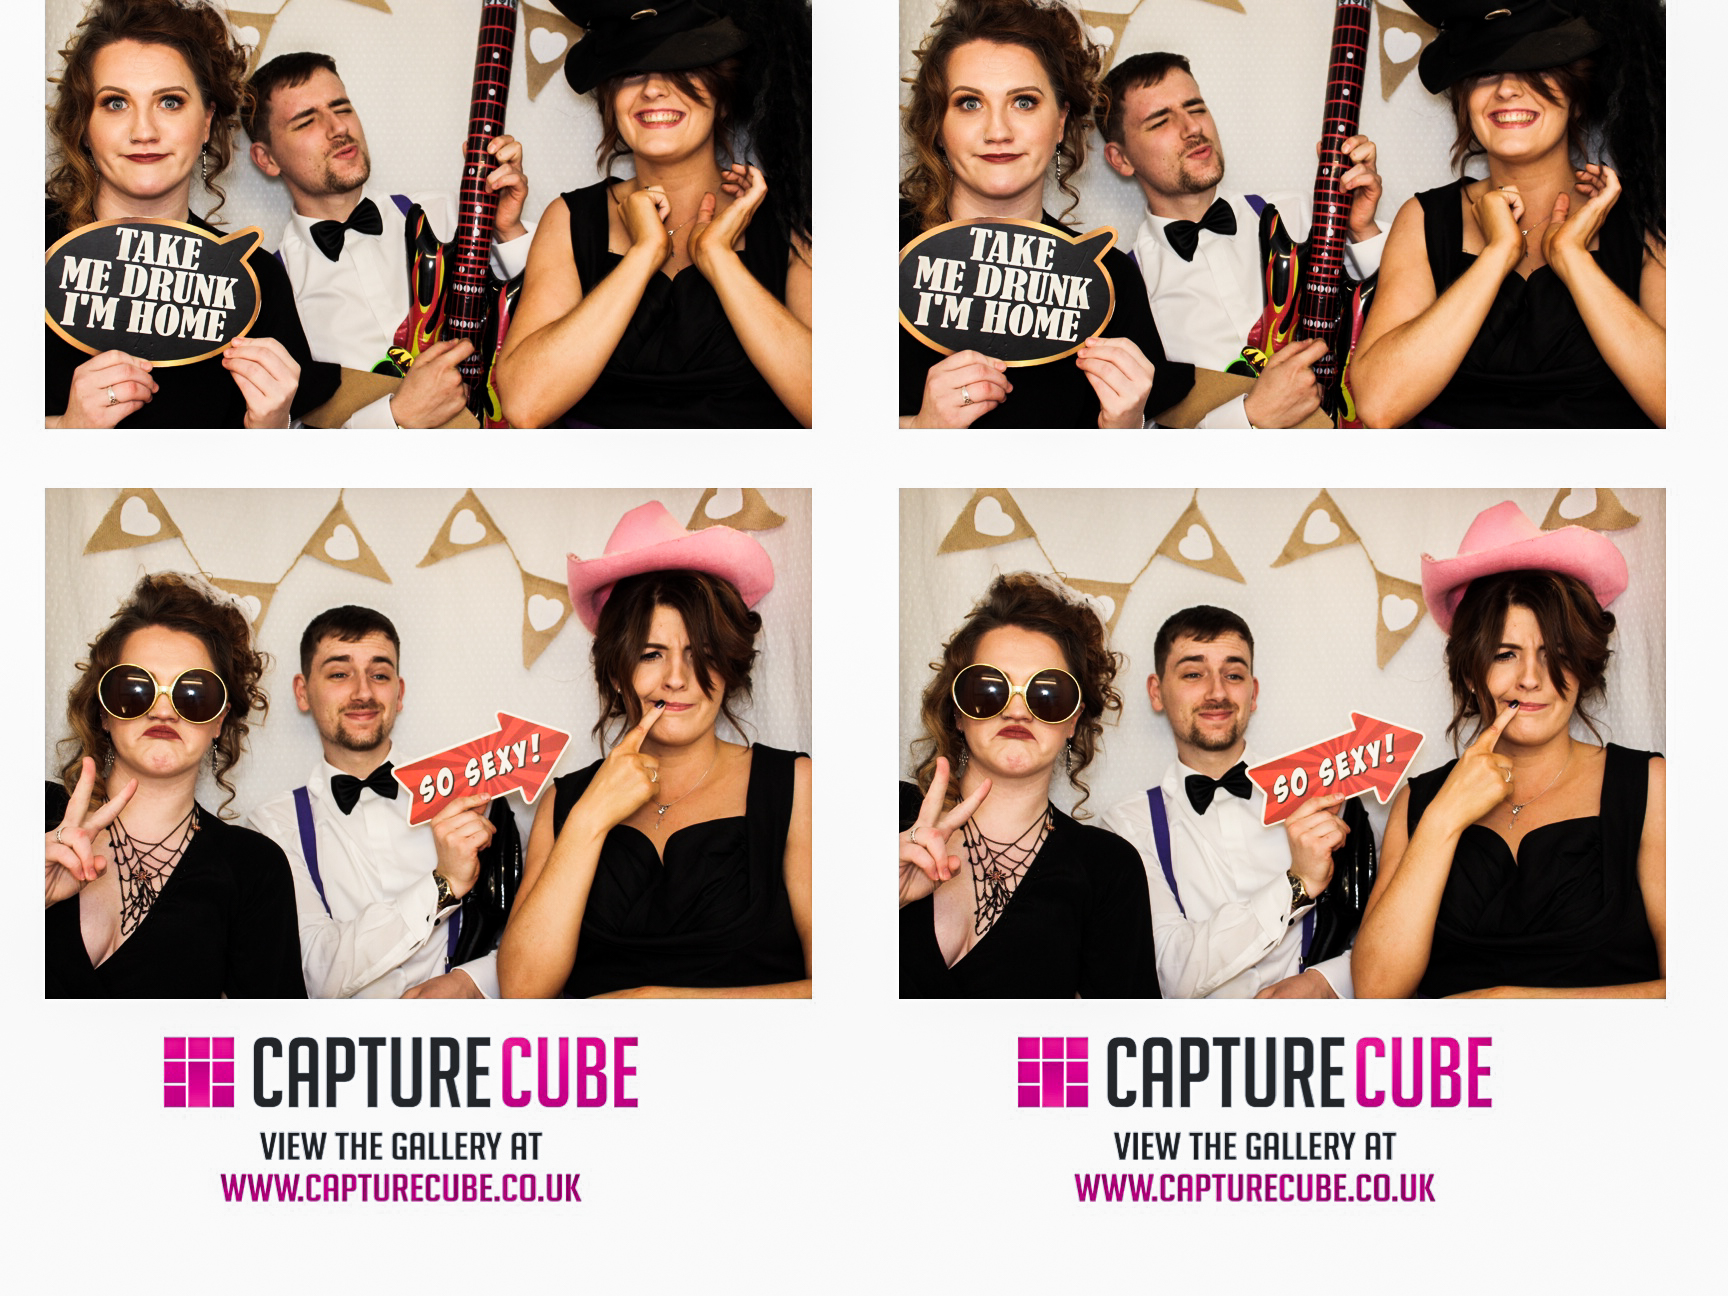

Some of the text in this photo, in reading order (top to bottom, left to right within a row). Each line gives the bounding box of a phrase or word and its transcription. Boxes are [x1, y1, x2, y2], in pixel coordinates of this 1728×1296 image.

[115, 226, 203, 271] TAKE
[969, 226, 1057, 271] TAKE
[58, 255, 239, 310] ME DRUNK
[912, 255, 1093, 310] ME DRUNK
[59, 291, 228, 343] I'M HOME
[913, 291, 1082, 343] I'M HOME
[419, 732, 542, 804] SO SEXY!
[1273, 732, 1396, 804] SO SEXY!
